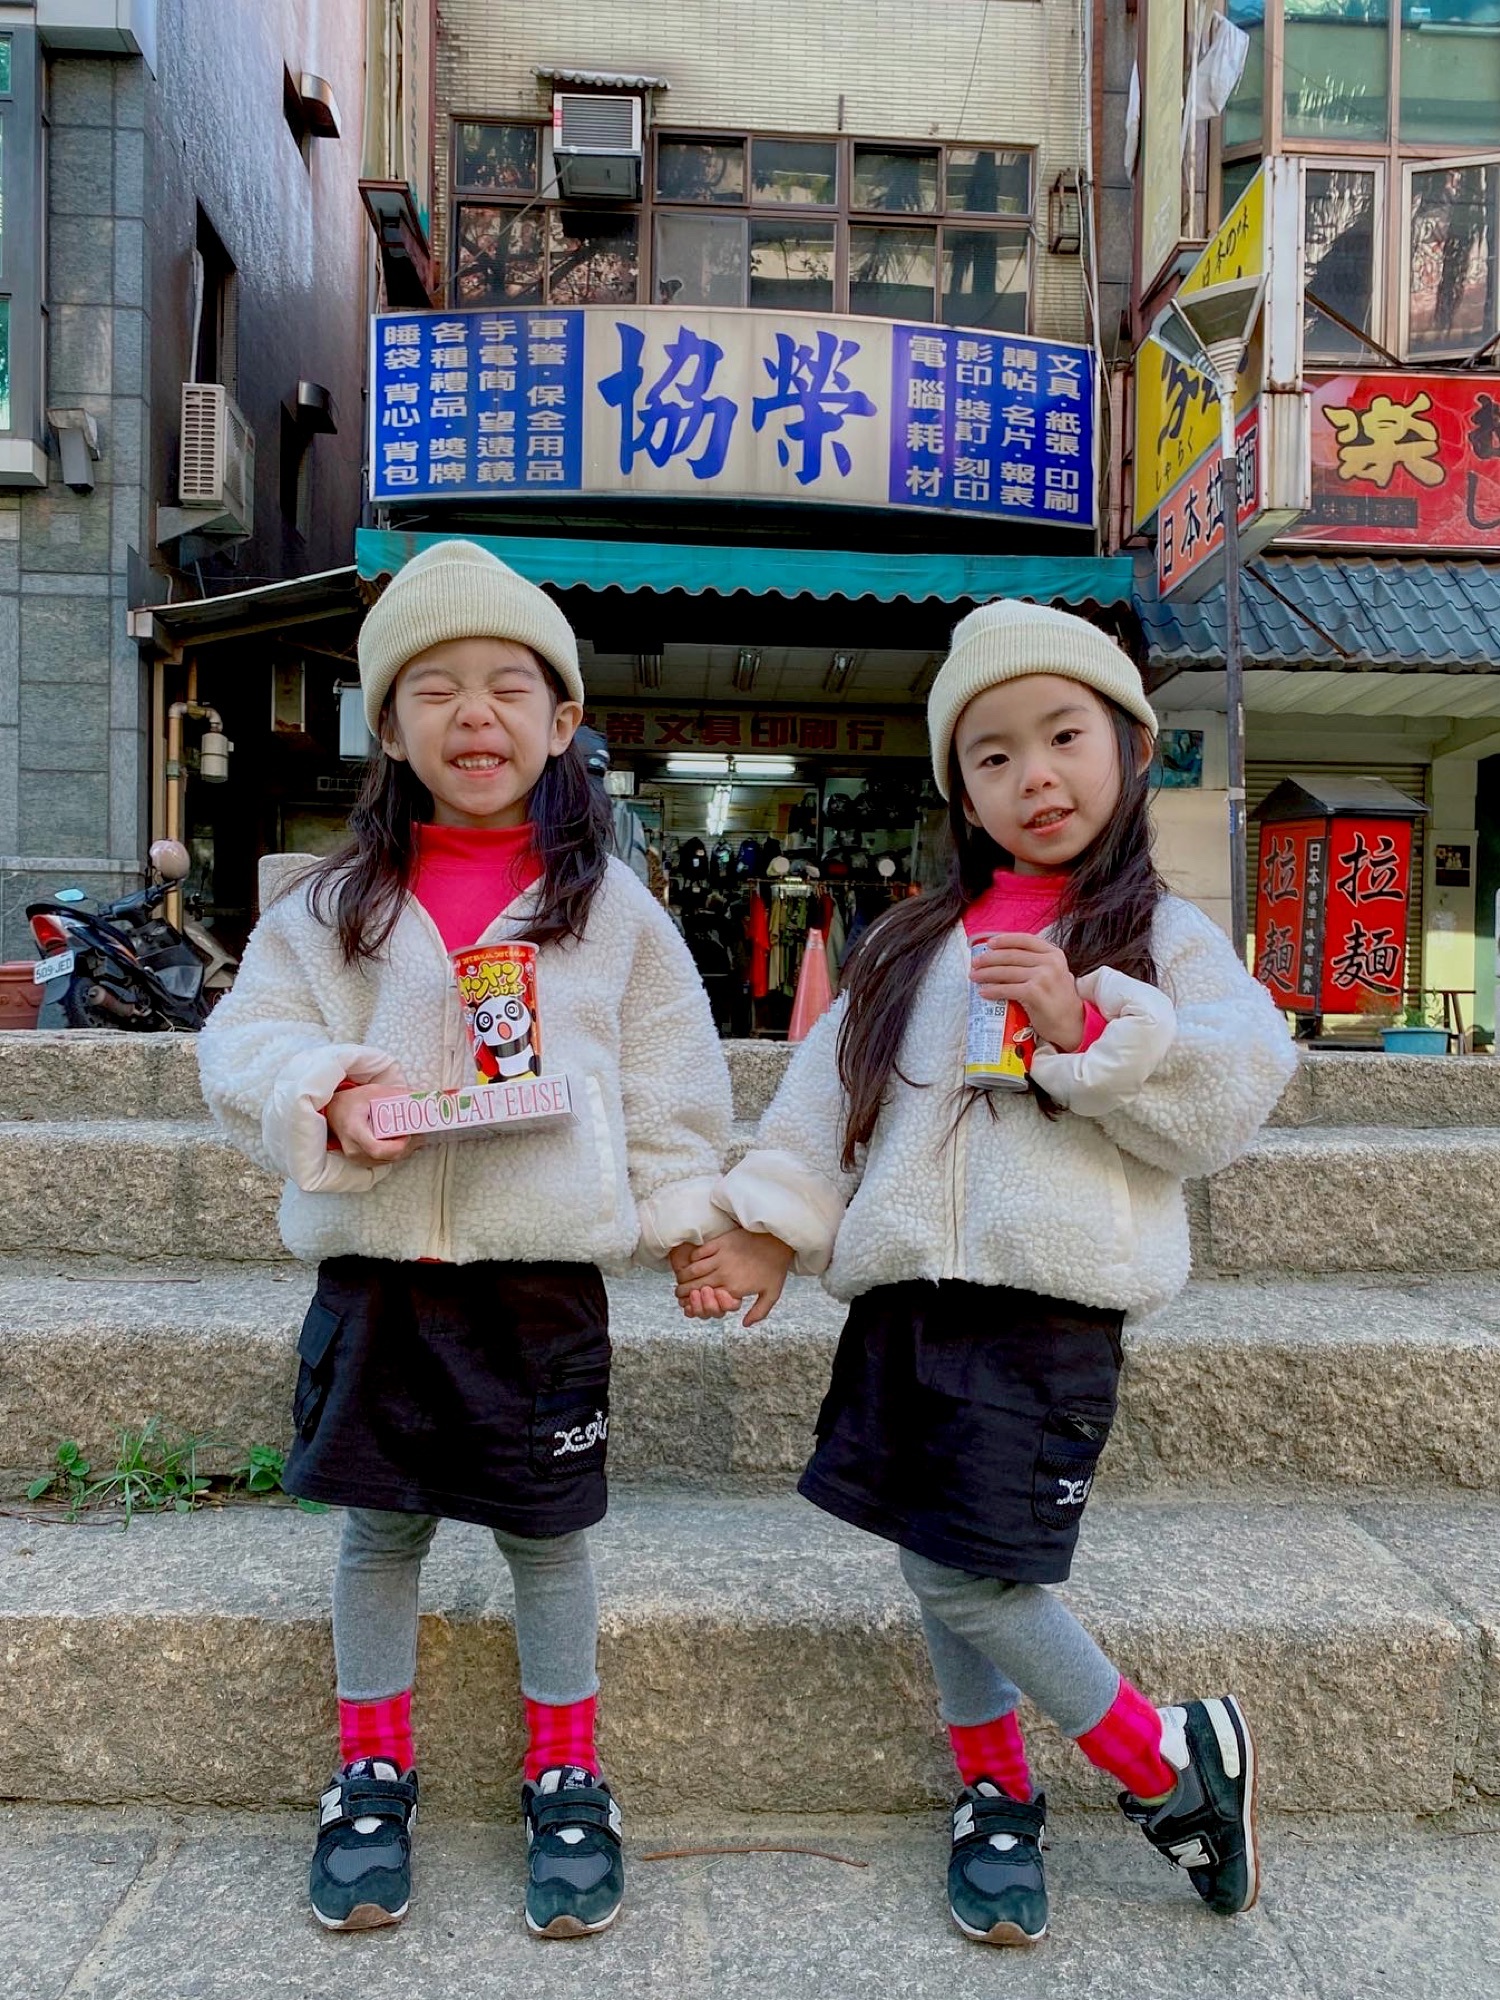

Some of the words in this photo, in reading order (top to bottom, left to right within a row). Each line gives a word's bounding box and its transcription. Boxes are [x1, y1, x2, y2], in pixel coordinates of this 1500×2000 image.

[904, 334, 947, 499] 電腦耗材
[583, 711, 886, 751] 榮文具印刷行
[376, 1090, 497, 1135] CHOCOLAT
[505, 1080, 566, 1118] ELISE
